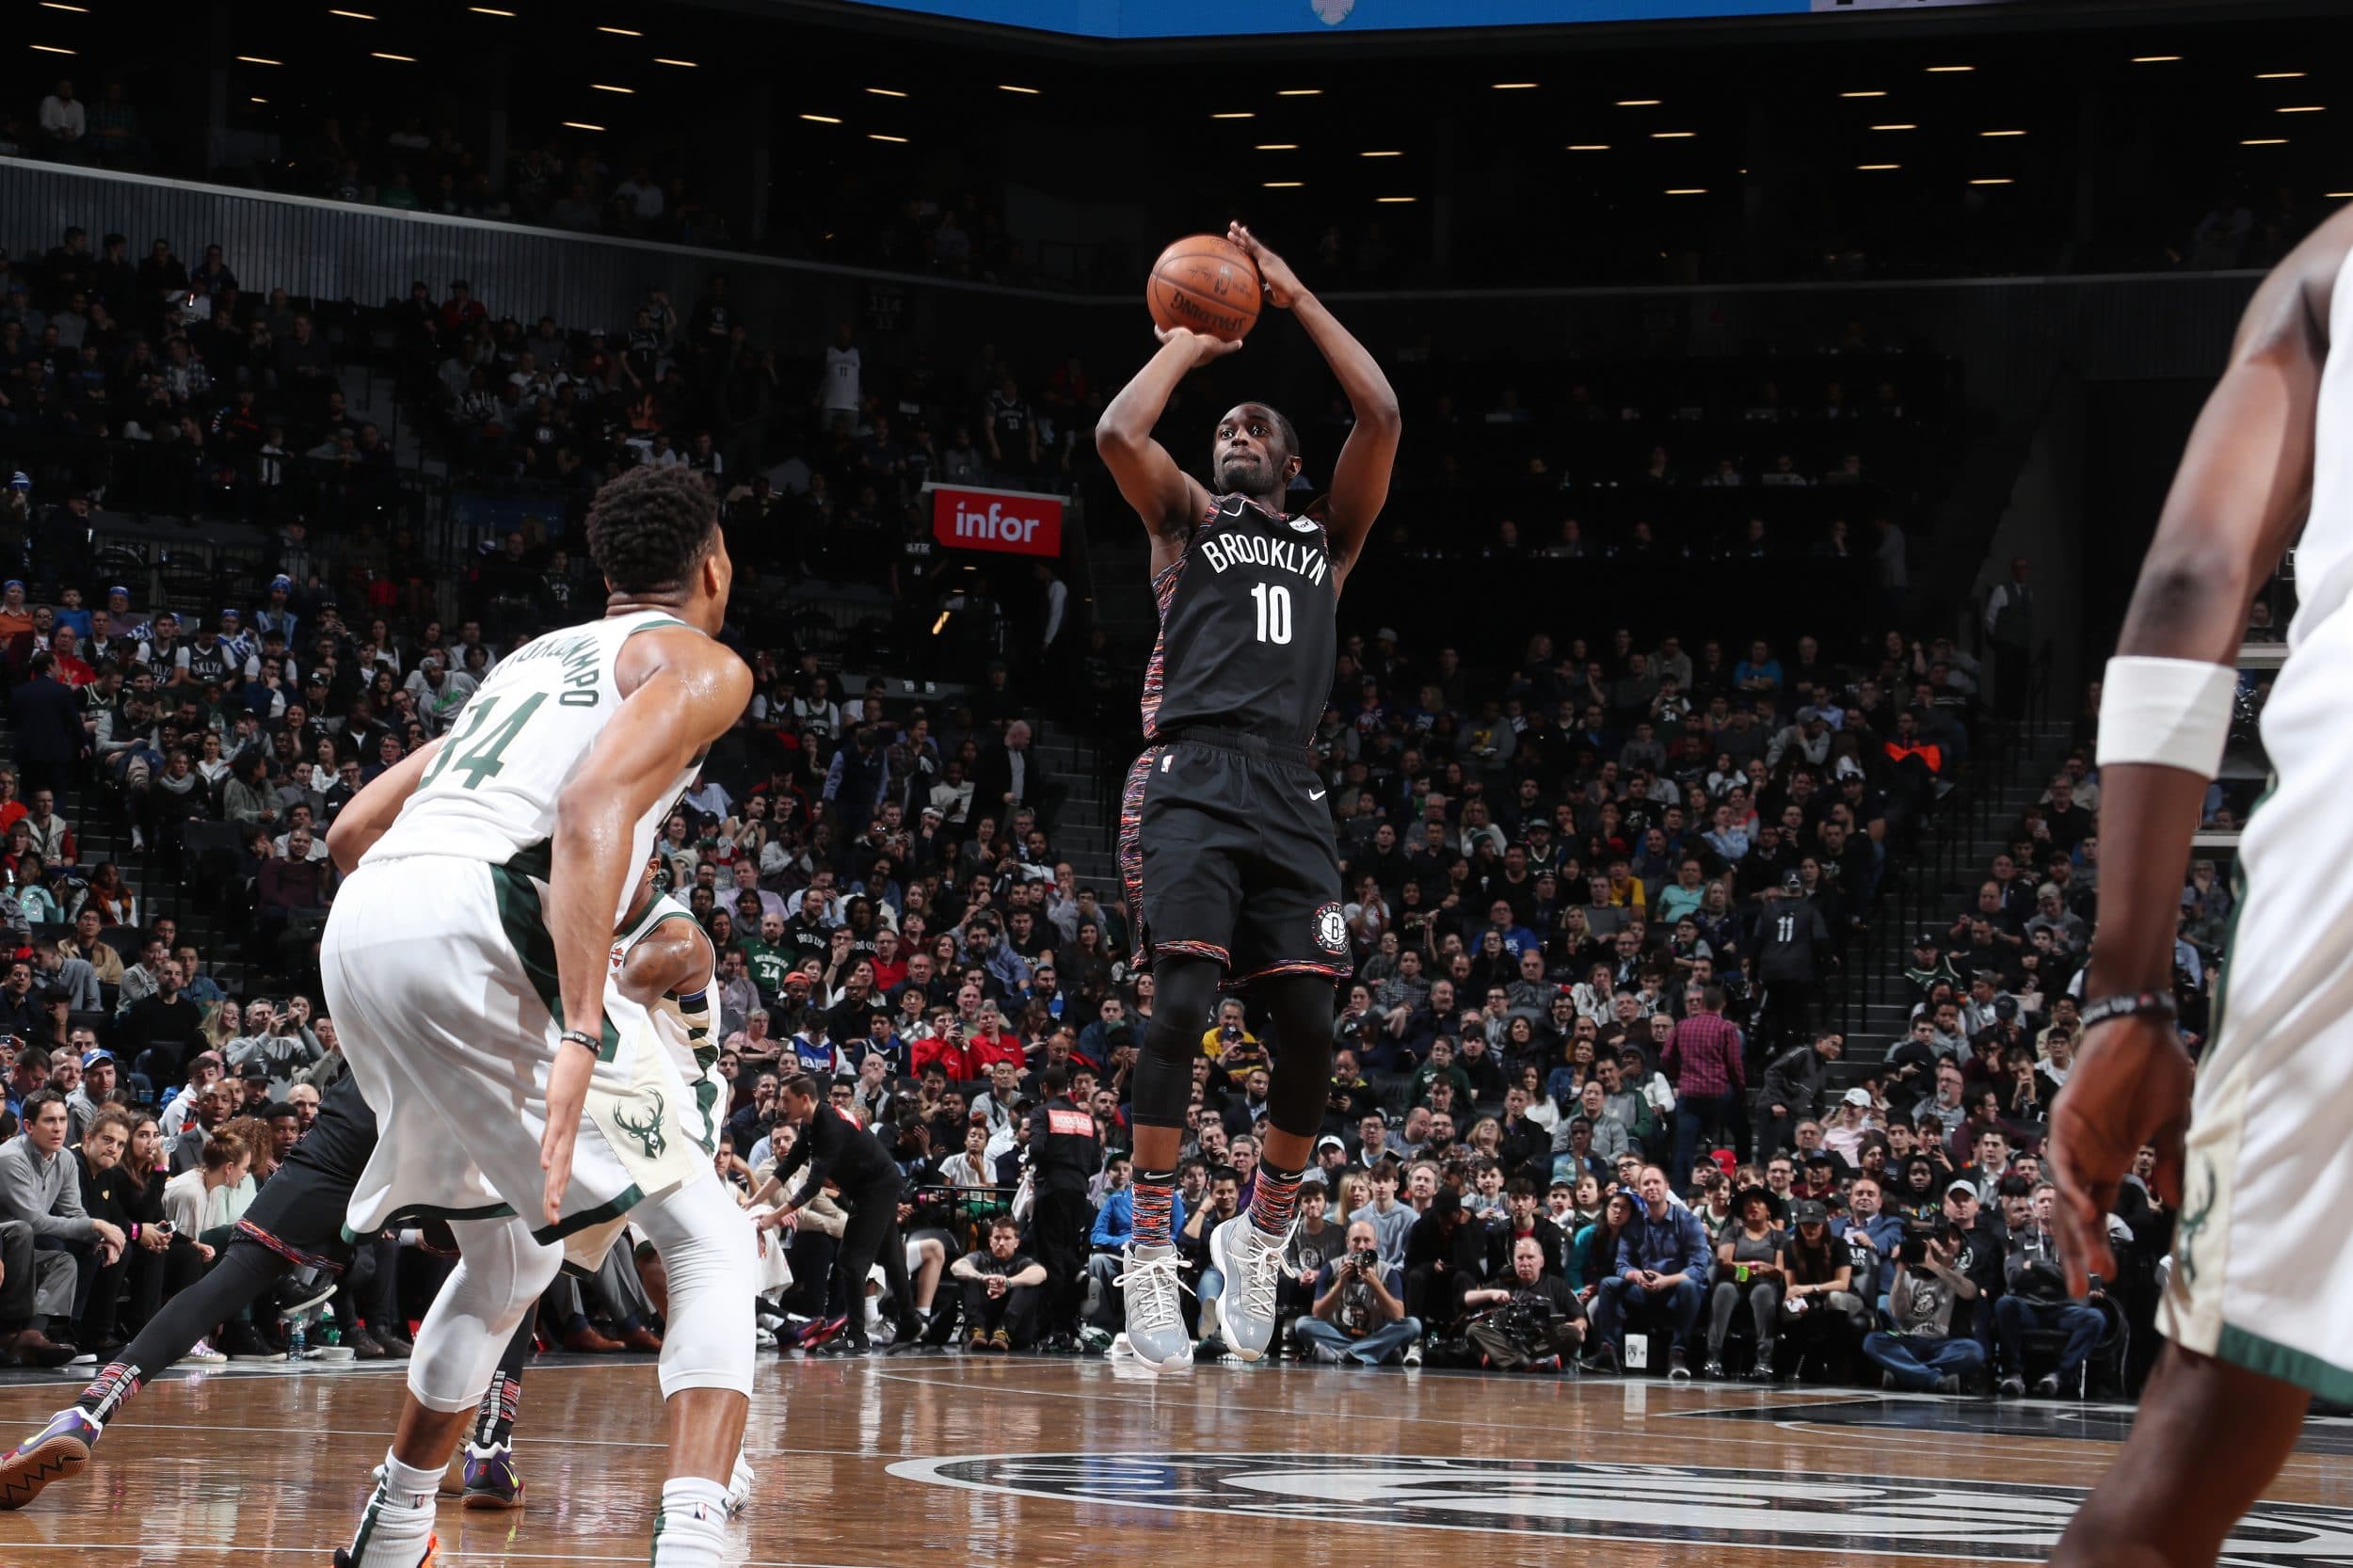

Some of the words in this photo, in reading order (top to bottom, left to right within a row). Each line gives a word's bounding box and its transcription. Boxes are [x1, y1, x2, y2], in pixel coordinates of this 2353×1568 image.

[954, 500, 1040, 543] infor
[1200, 533, 1327, 586] BROOKLYN
[1250, 582, 1292, 645] 10
[1776, 916, 1795, 942] 11
[760, 963, 780, 981] 34
